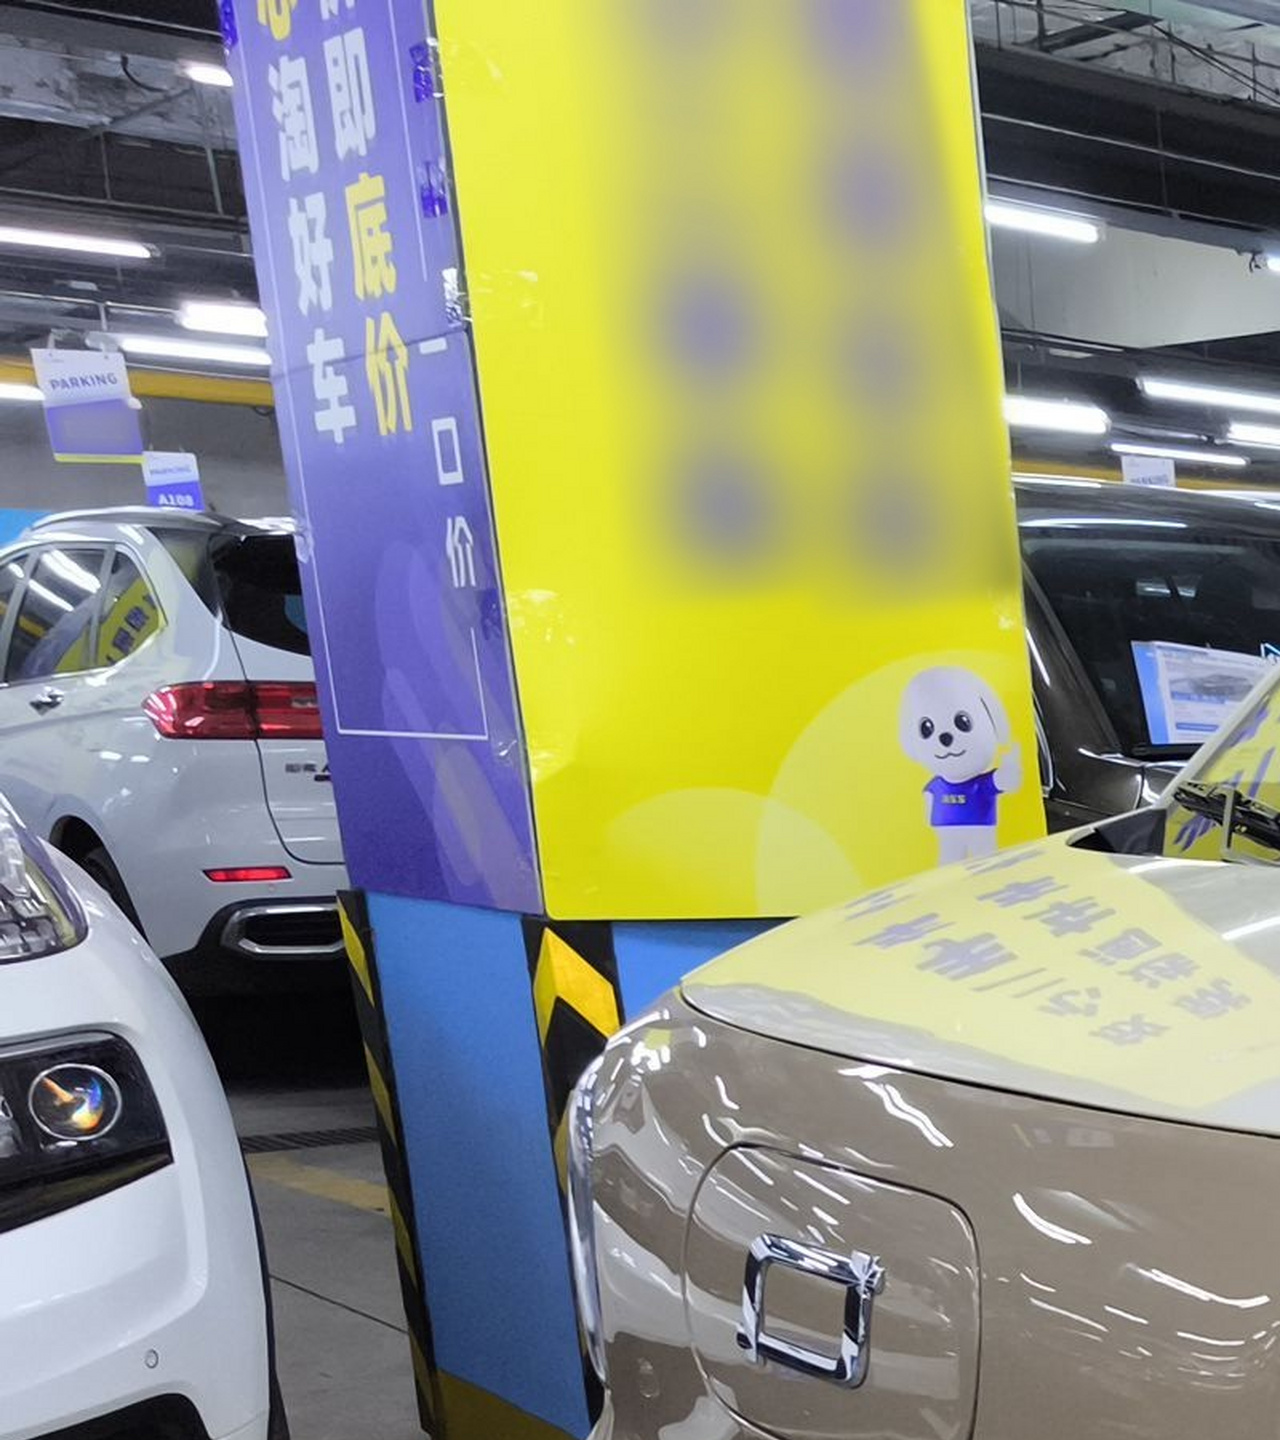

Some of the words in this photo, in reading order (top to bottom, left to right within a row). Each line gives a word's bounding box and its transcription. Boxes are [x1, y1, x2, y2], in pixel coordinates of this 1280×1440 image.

[319, 0, 413, 436] 即底价
[50, 373, 118, 391] PARKING
[419, 337, 477, 588] 一口价
